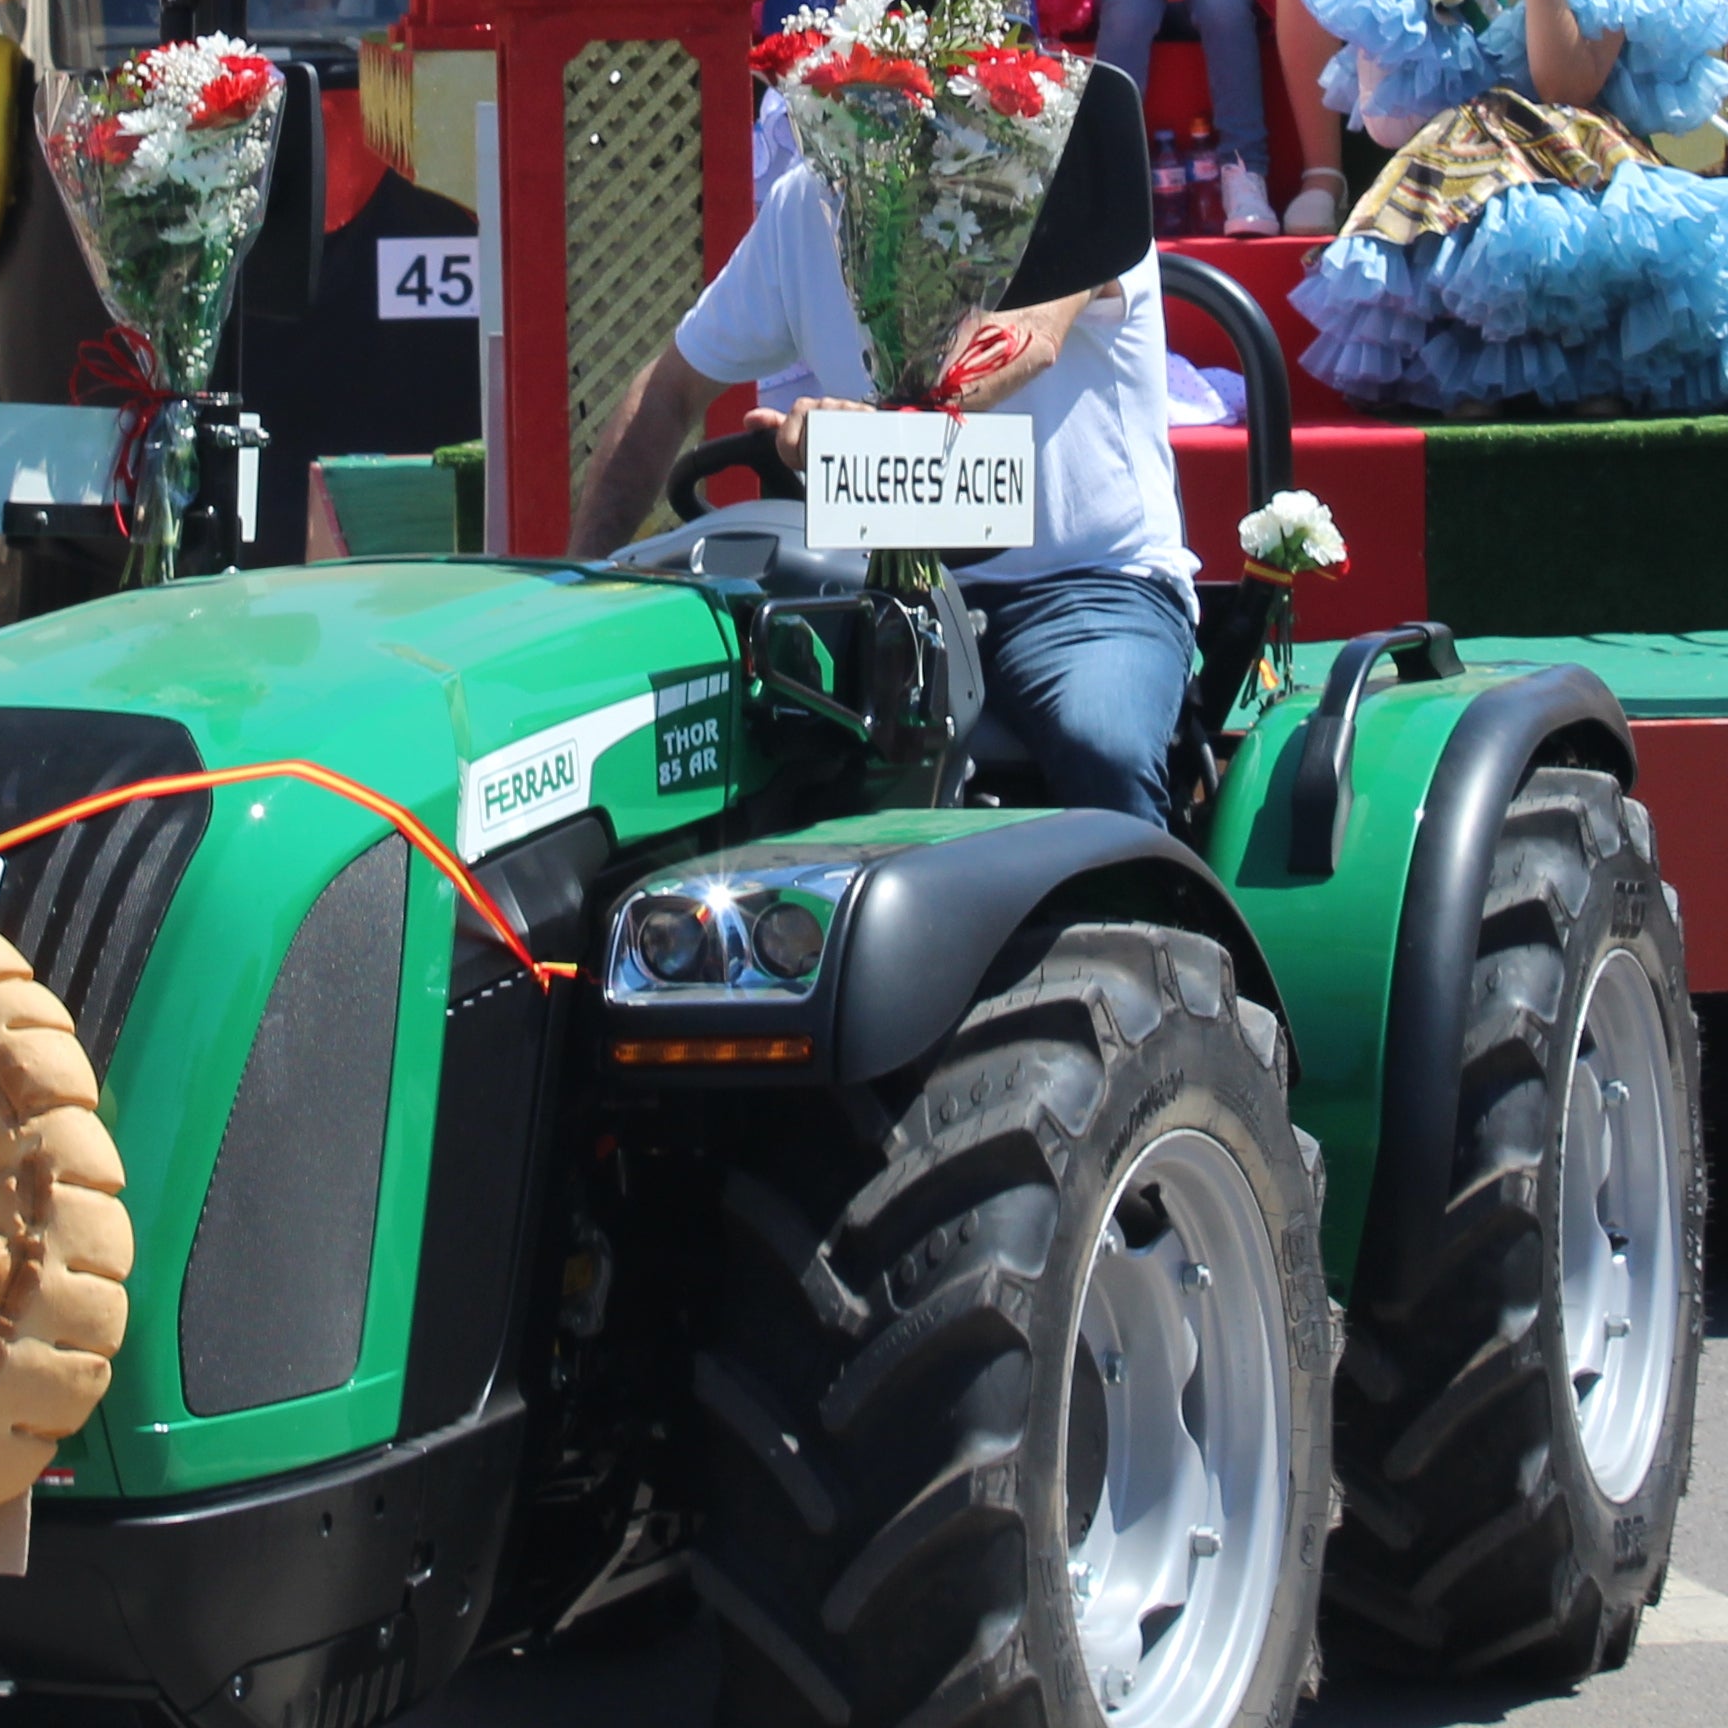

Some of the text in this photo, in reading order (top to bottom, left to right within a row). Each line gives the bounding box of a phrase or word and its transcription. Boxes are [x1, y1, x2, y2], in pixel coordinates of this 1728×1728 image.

[395, 254, 474, 306] 45
[820, 455, 1024, 505] TALLERES ACIEN
[662, 718, 719, 756] THOR
[483, 750, 574, 820] FERRARI
[658, 746, 718, 786] 85 AR
